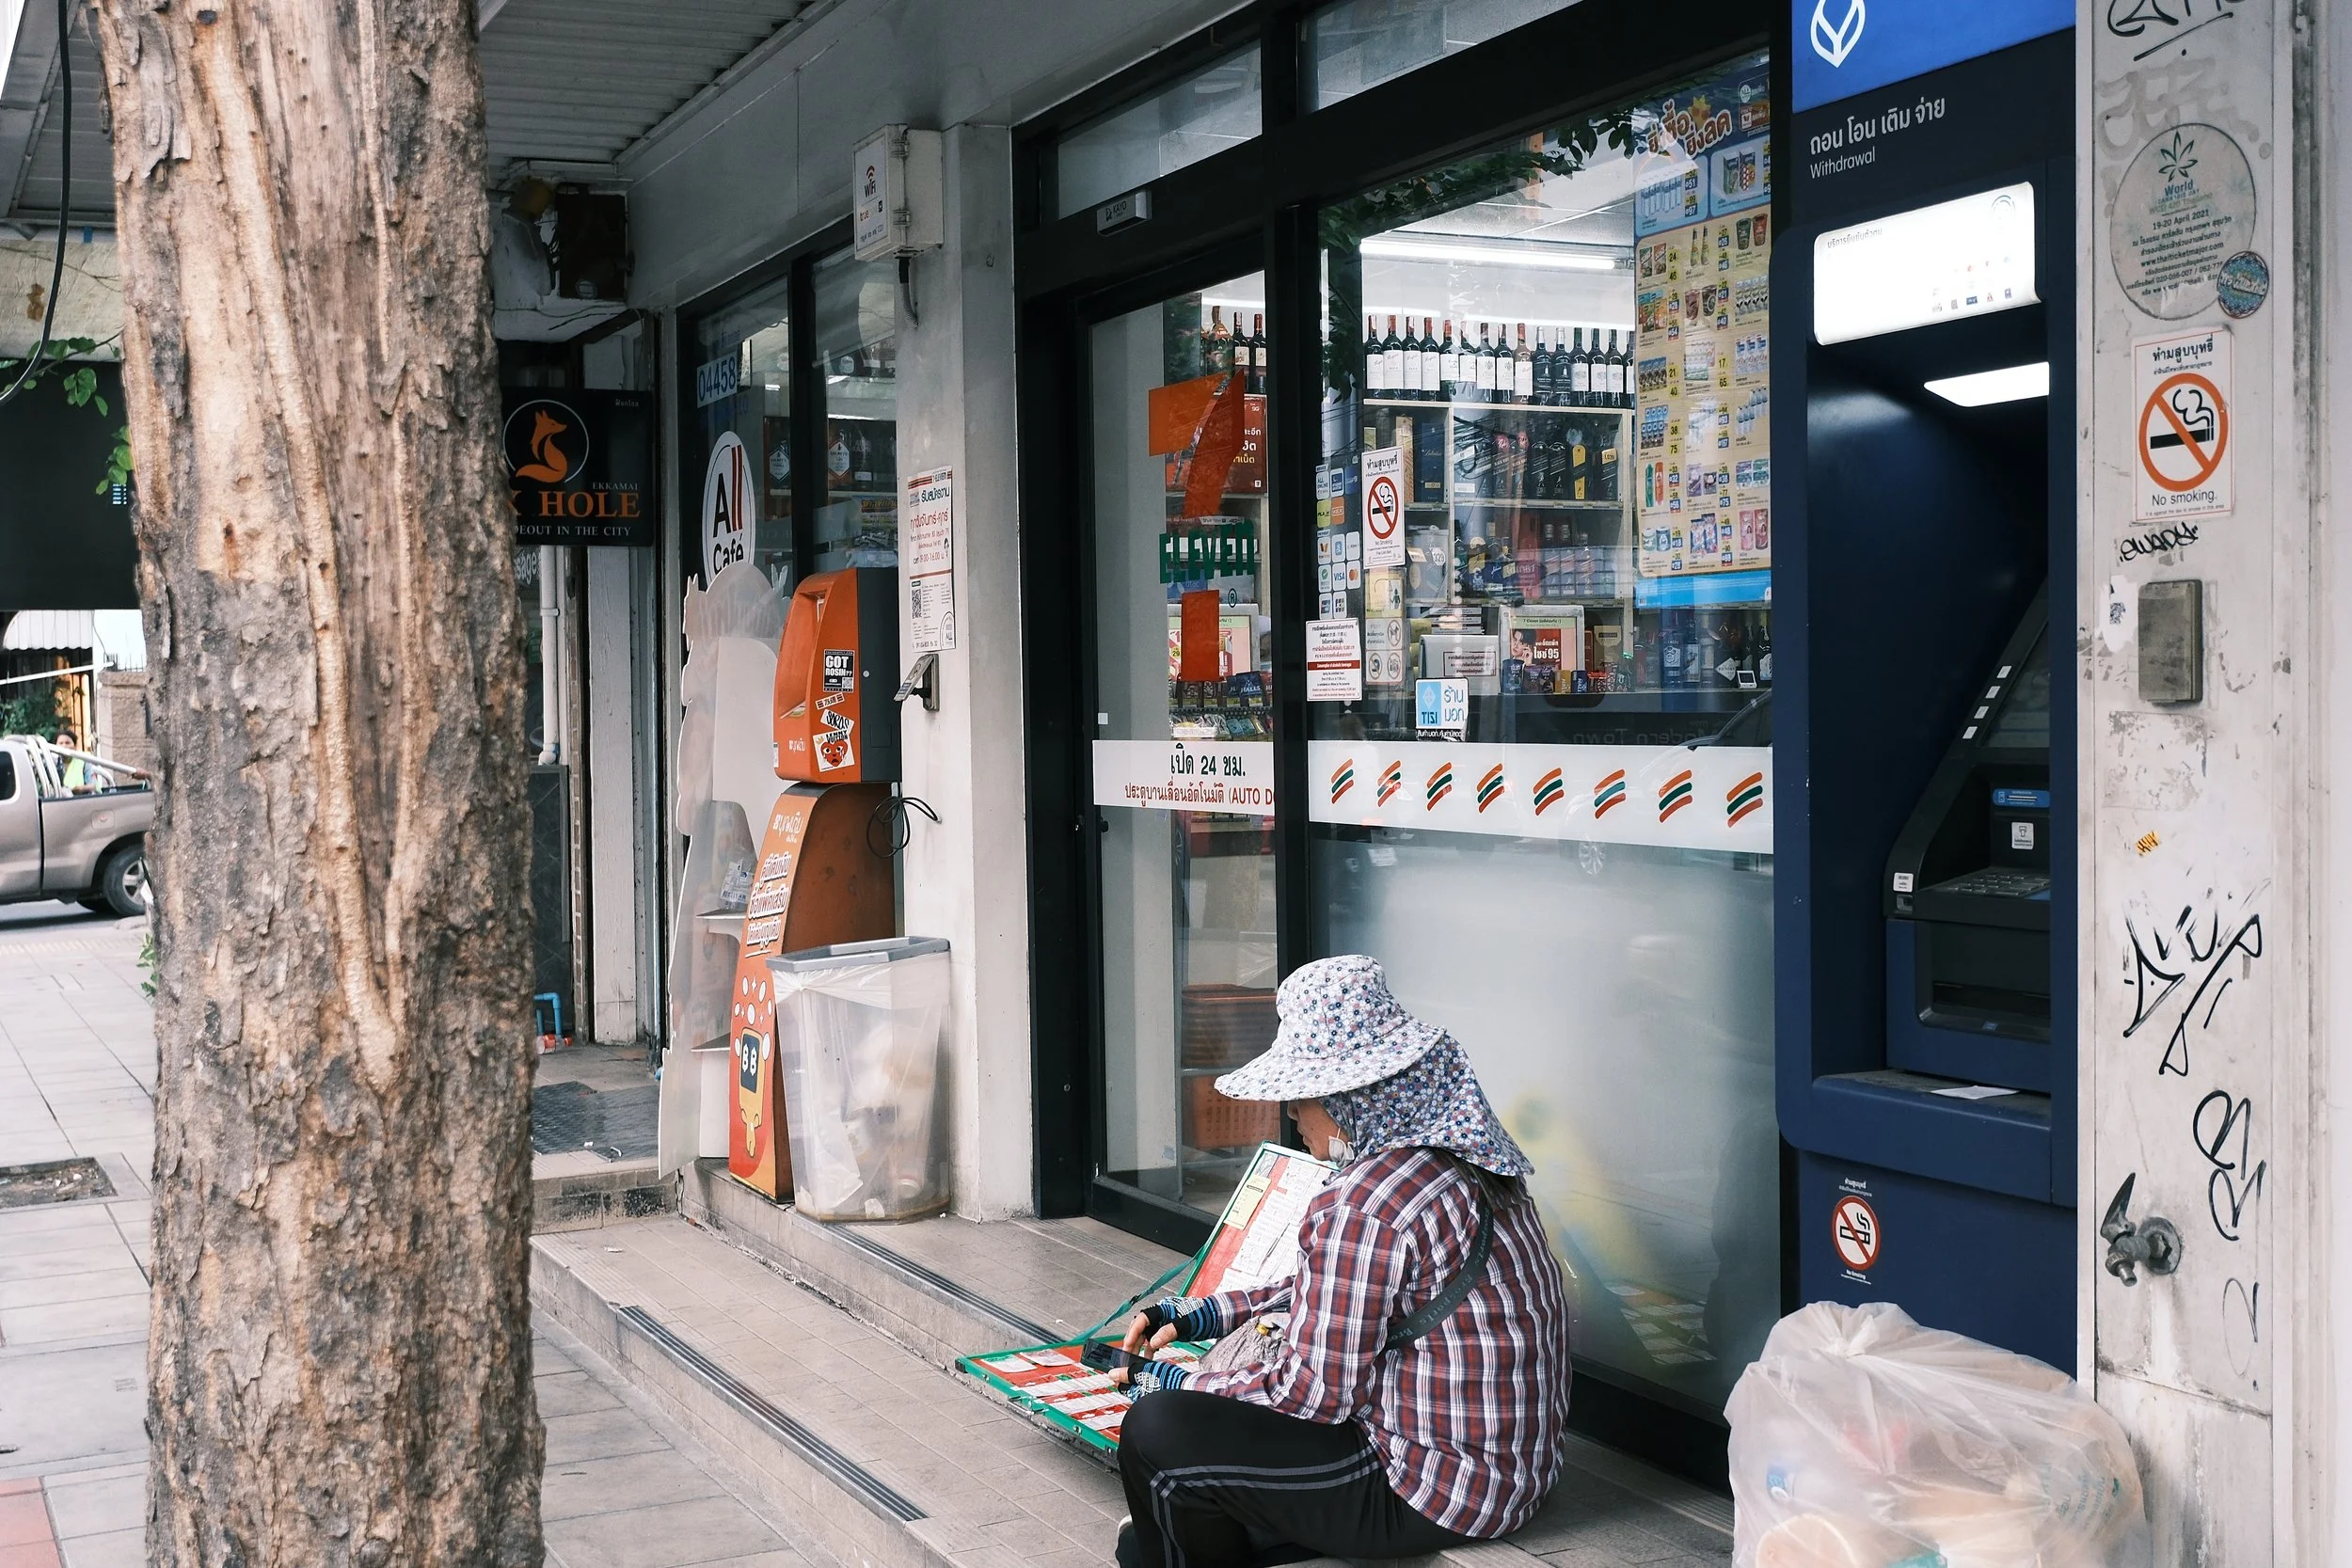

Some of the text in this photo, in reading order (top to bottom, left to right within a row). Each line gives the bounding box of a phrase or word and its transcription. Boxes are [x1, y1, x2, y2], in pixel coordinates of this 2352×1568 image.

[1810, 97, 1945, 155] ถอน โอน เติม จ่าย
[1810, 146, 1875, 179] Withdrawal
[2164, 180, 2194, 197] World
[2153, 209, 2210, 230] 19-20 April 2021
[2141, 242, 2224, 267] www.thaiticketmajor.com
[2153, 332, 2213, 363] ห้ามสูบบุหรี่
[699, 356, 736, 403] 04458
[1367, 454, 1398, 471] ห้ามสูบบุหรี่
[593, 482, 638, 490] EKKAMAI
[538, 490, 641, 517] HOLE
[2152, 494, 2167, 506] No
[558, 525, 569, 535] IN
[575, 526, 598, 536] THE
[604, 527, 632, 536] CITY
[1333, 572, 1345, 581] VISA
[825, 655, 849, 668] GOT
[1241, 685, 1261, 693] HALLS
[1444, 685, 1464, 703] ร้าน
[1170, 742, 1247, 777] เปิด 24 ชม.
[1125, 776, 1225, 807] ประตูบานเลื่อนอัตโนมัติ
[1229, 787, 1261, 805] (AUTO
